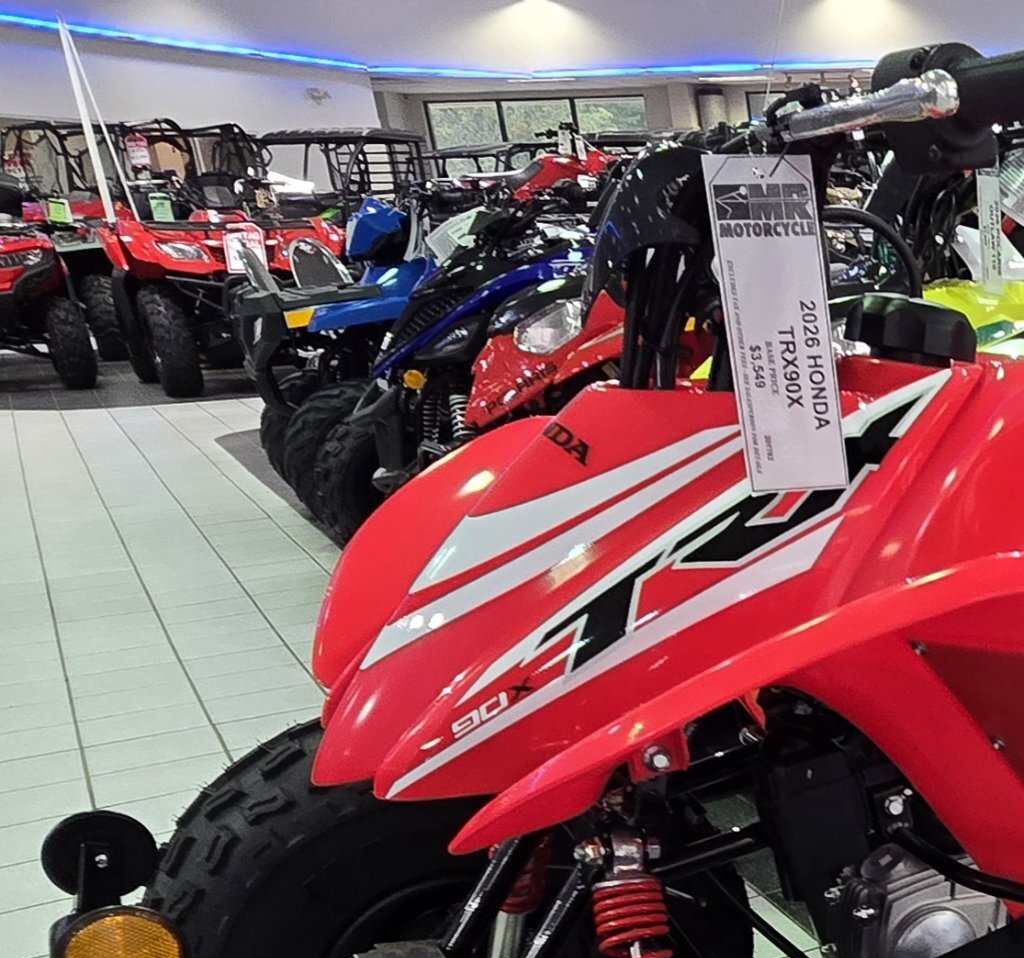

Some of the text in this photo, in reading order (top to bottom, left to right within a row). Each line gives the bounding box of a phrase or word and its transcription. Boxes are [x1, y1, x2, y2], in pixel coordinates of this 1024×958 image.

[719, 221, 817, 238] MOTORCYCLE
[749, 345, 767, 389] $3,549
[769, 368, 780, 395] PRICE
[778, 325, 805, 409] TRX90X
[799, 300, 831, 431] 2026 HONDA
